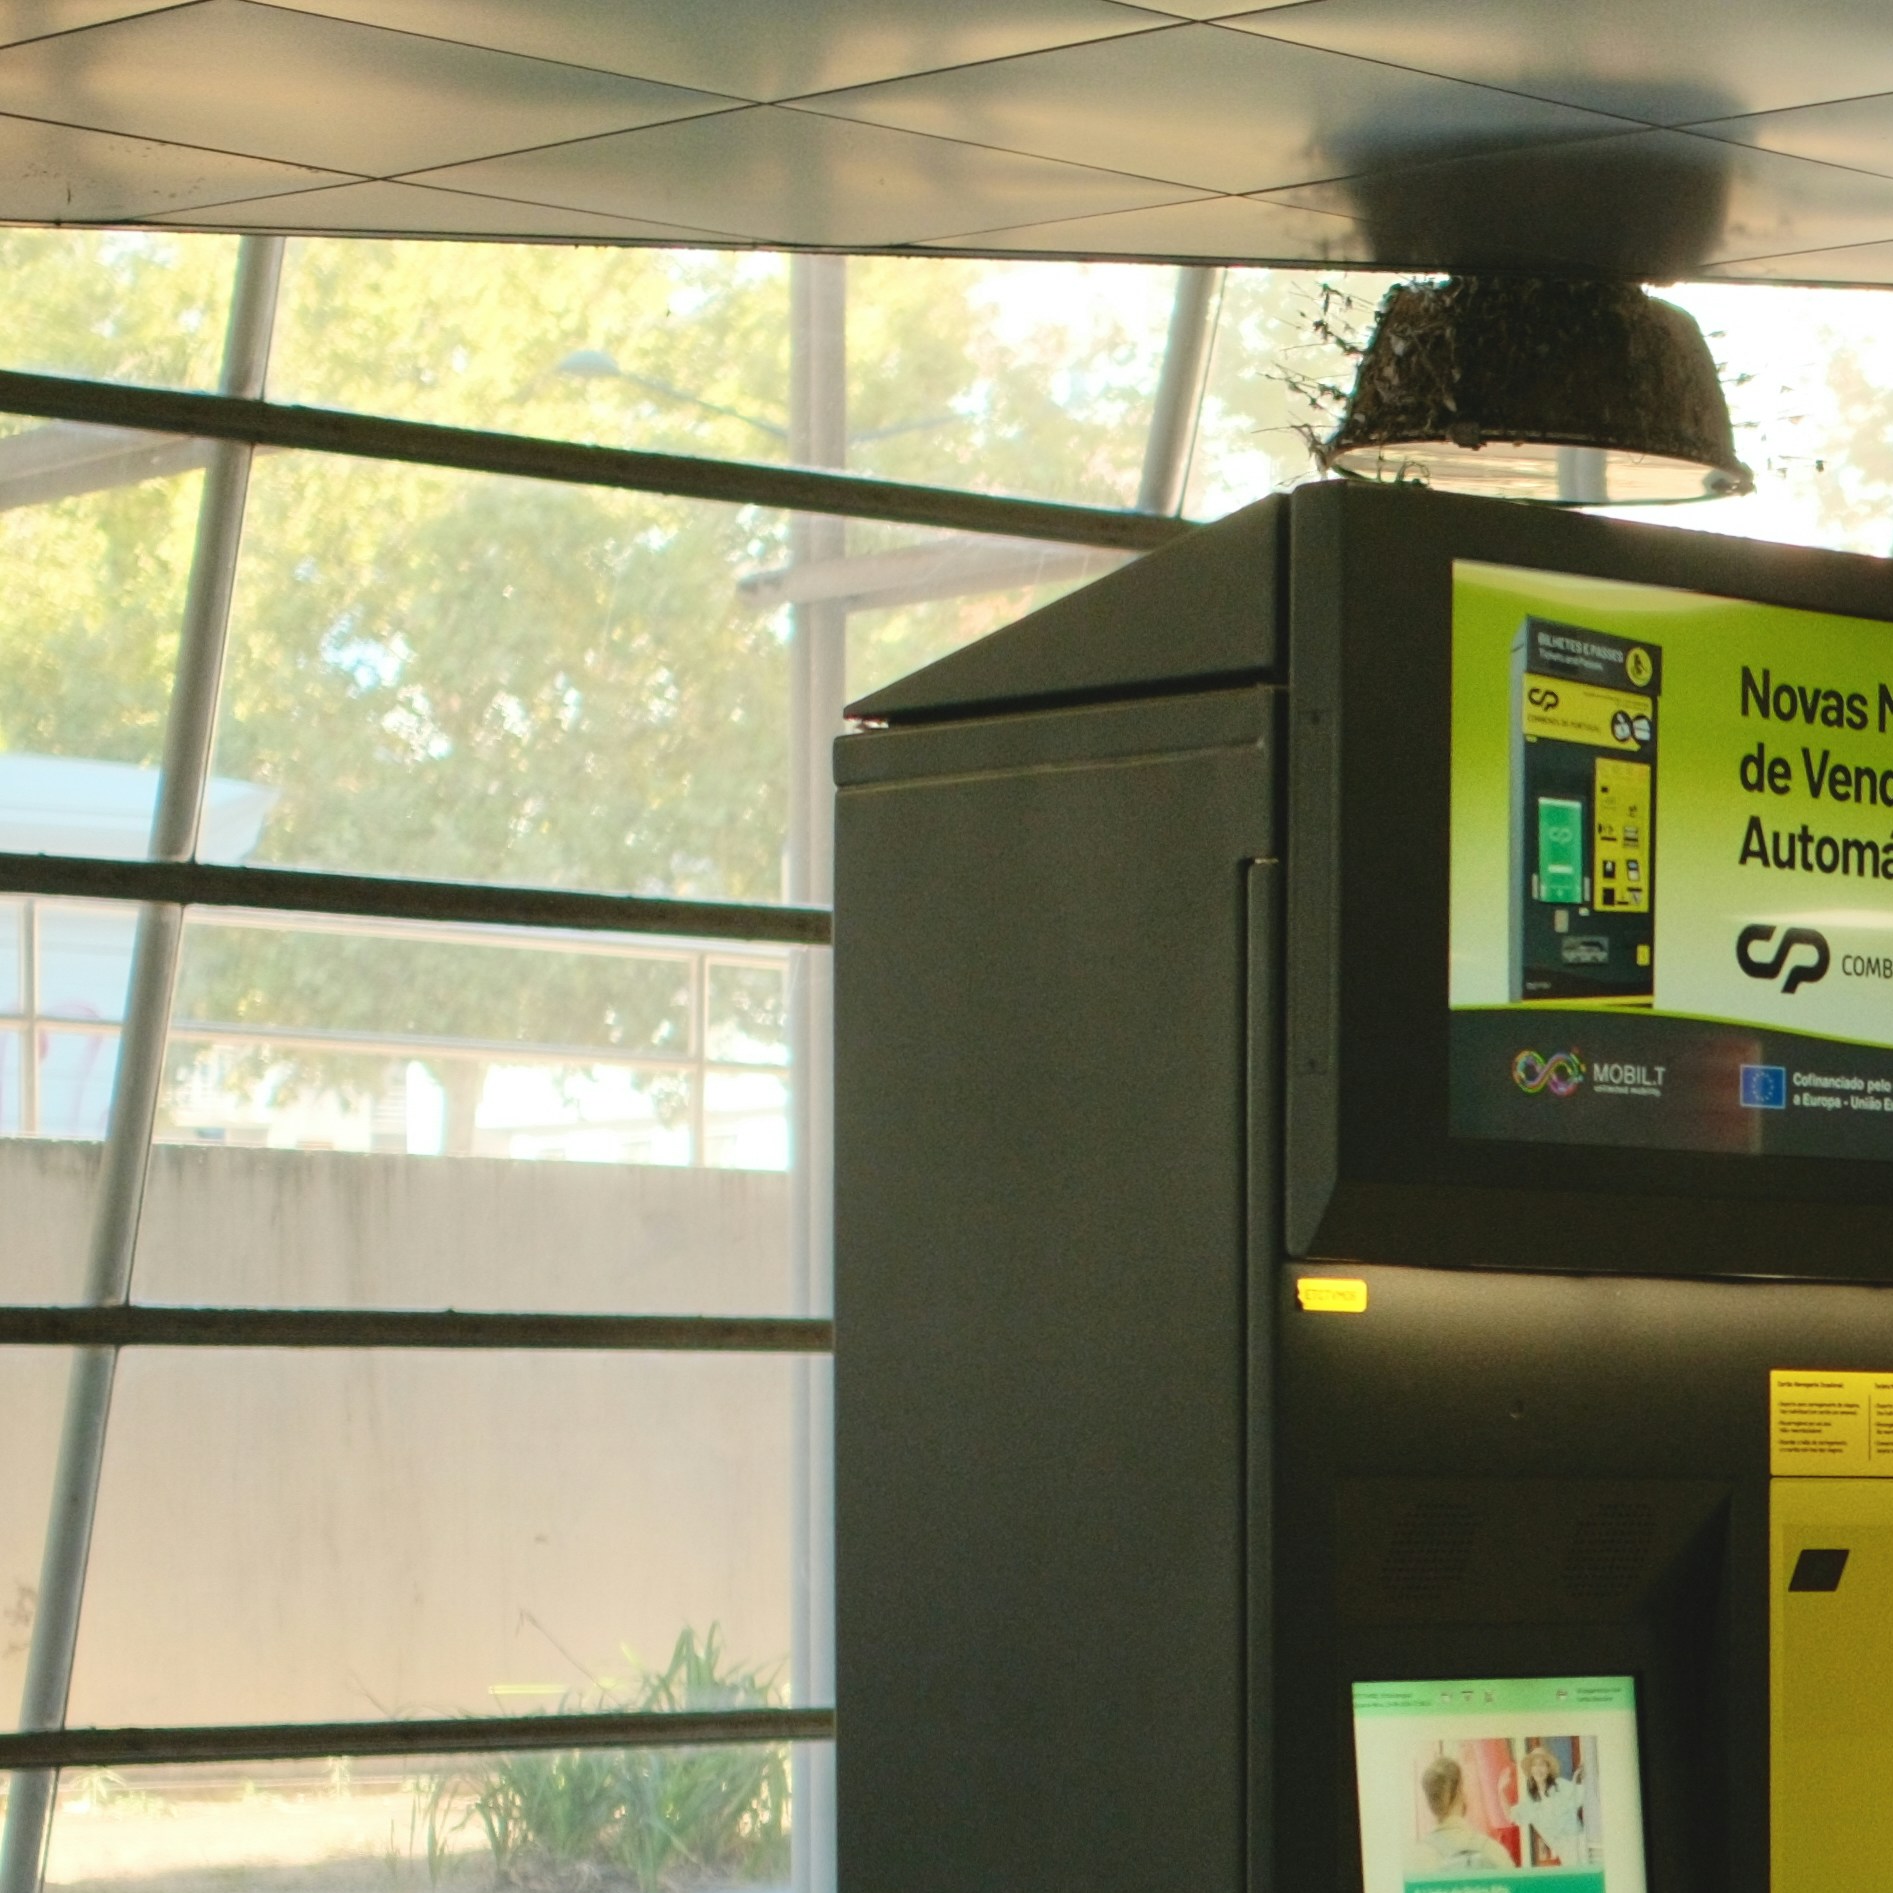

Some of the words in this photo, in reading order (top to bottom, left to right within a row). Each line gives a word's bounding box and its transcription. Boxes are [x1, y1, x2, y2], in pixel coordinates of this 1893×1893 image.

[1740, 665, 1868, 731] Novas
[1740, 742, 1793, 794] de
[1793, 1071, 1864, 1092] Cofinanciado
[1867, 1078, 1891, 1094] pelo
[1803, 1093, 1842, 1111] Europa
[1851, 1095, 1881, 1112] União
